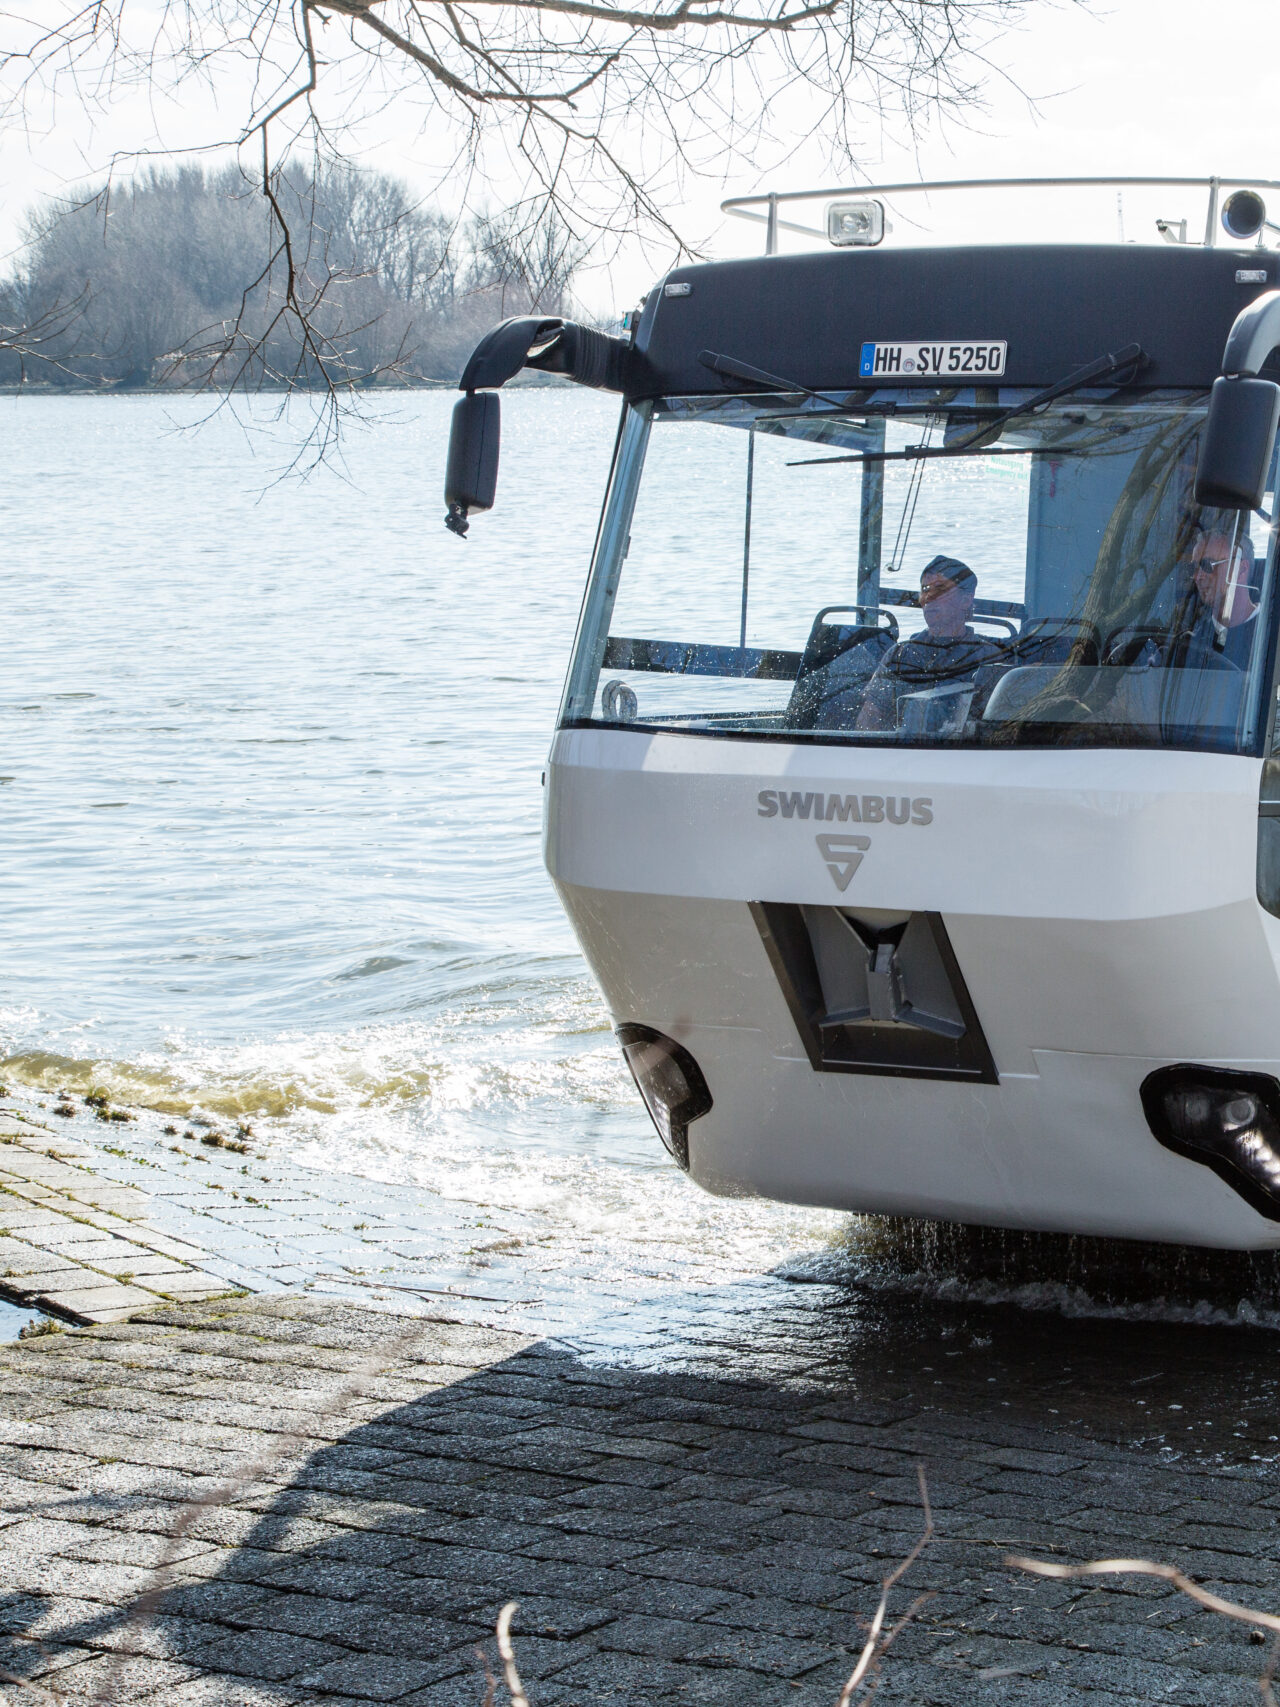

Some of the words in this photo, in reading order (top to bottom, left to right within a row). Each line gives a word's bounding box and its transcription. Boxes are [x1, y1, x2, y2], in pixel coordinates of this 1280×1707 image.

[864, 362, 870, 371] D
[874, 347, 901, 371] HH
[916, 346, 944, 372] SV
[948, 346, 1001, 371] 5250
[757, 790, 934, 826] SWIMBUS
